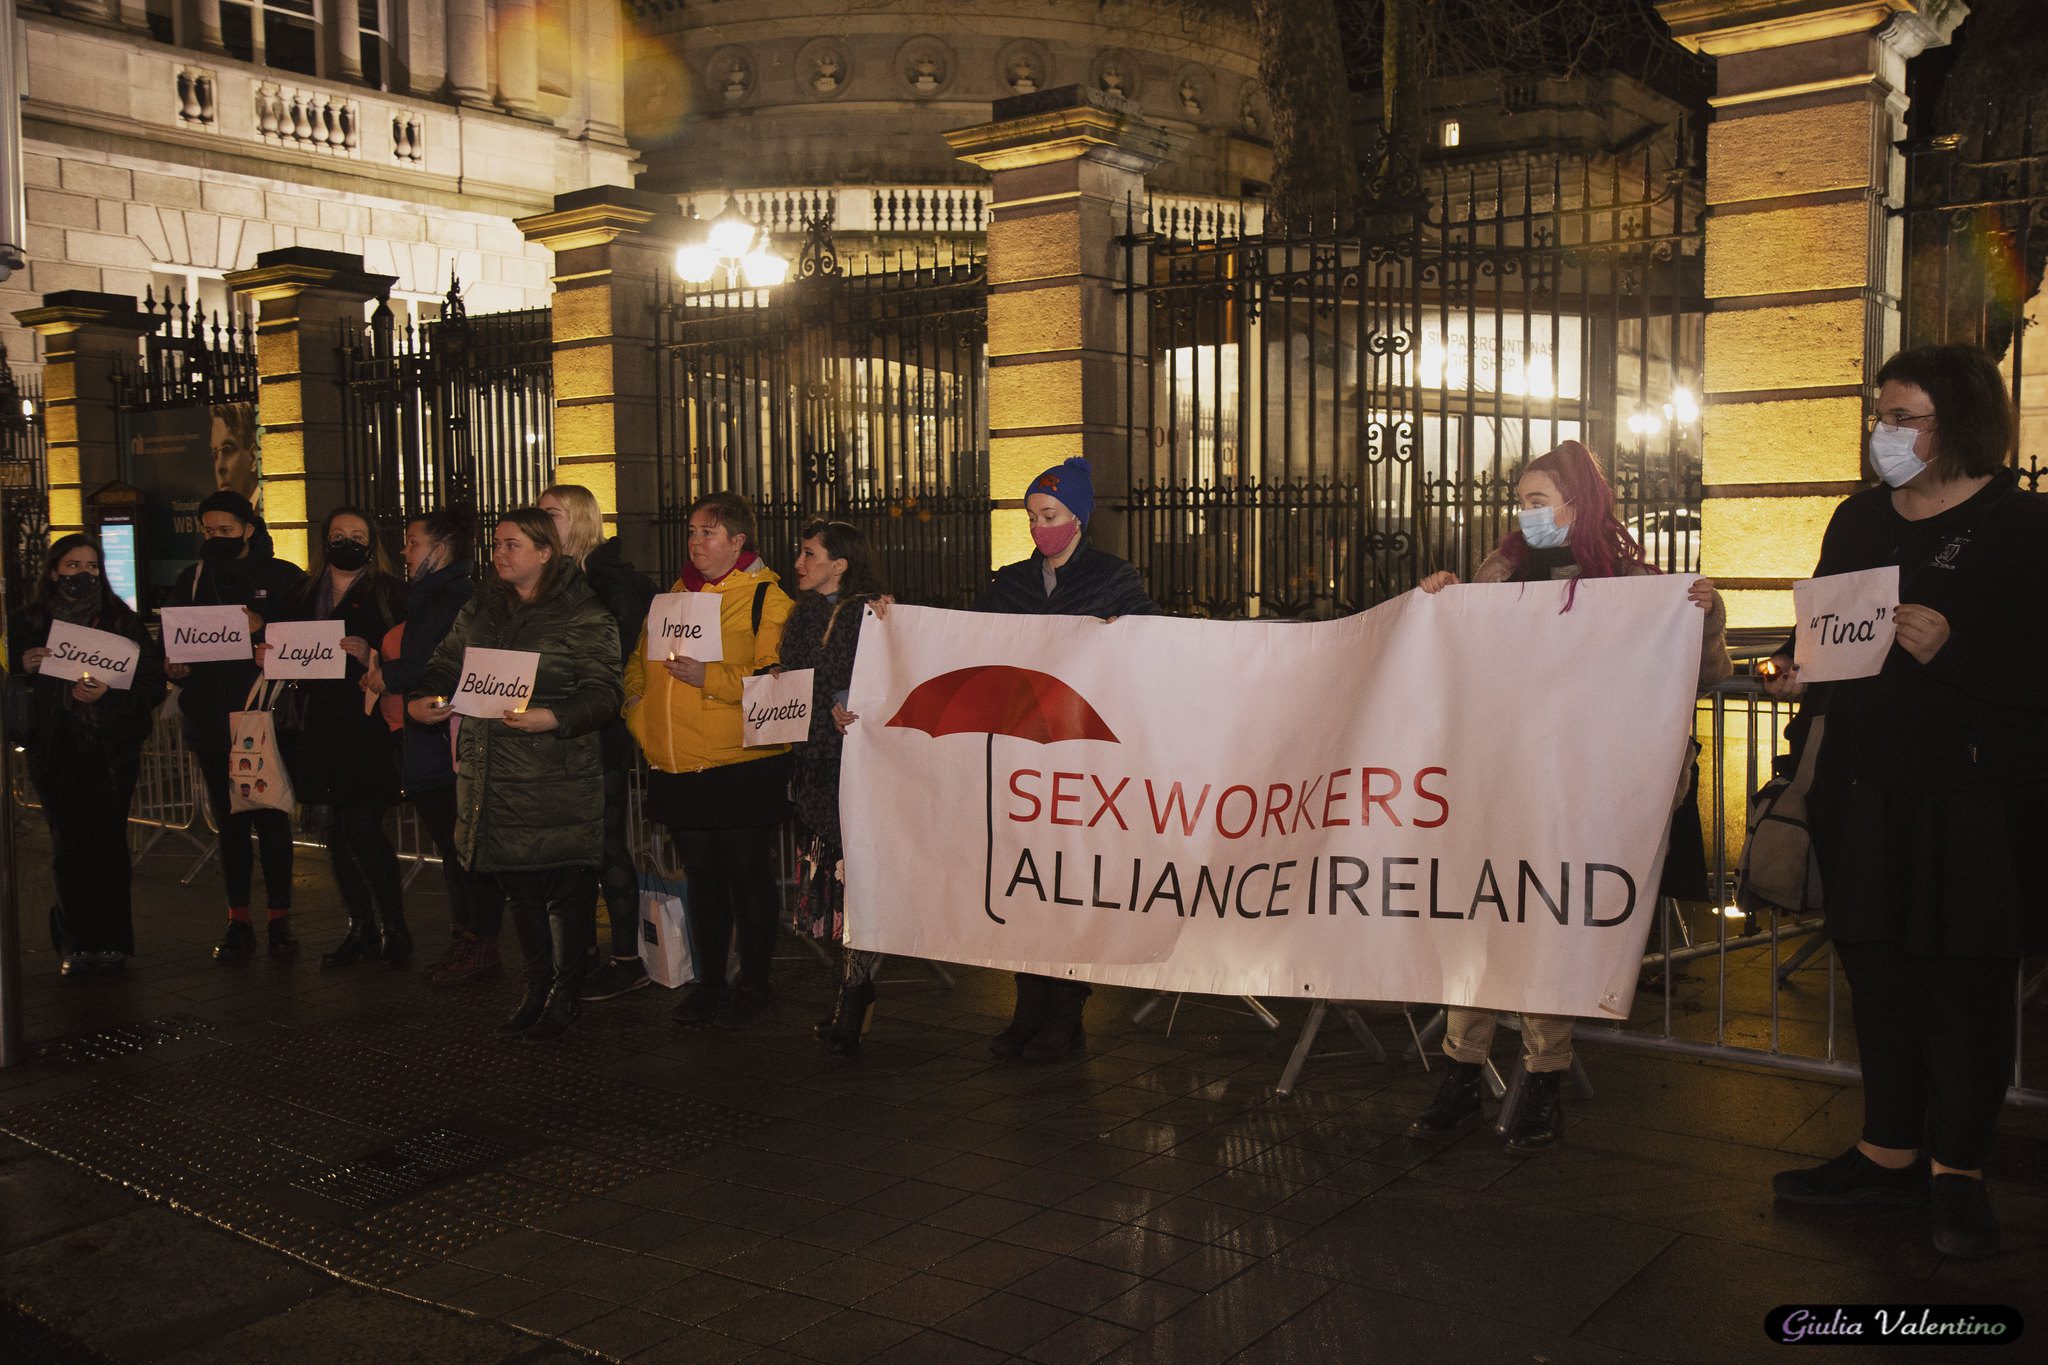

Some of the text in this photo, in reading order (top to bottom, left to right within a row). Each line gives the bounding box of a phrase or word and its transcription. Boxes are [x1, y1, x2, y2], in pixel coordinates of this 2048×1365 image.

[174, 625, 243, 646] Nicola
[661, 616, 703, 639] Irene
[1809, 606, 1886, 646] “Tina”
[53, 641, 131, 675] Sinéad
[277, 641, 334, 668] Layla
[460, 672, 530, 699] Belinda
[747, 700, 808, 730] Lynette
[1008, 766, 1450, 840] SEX WORKERS
[1004, 847, 1637, 928] ALLIANCE IRELAND
